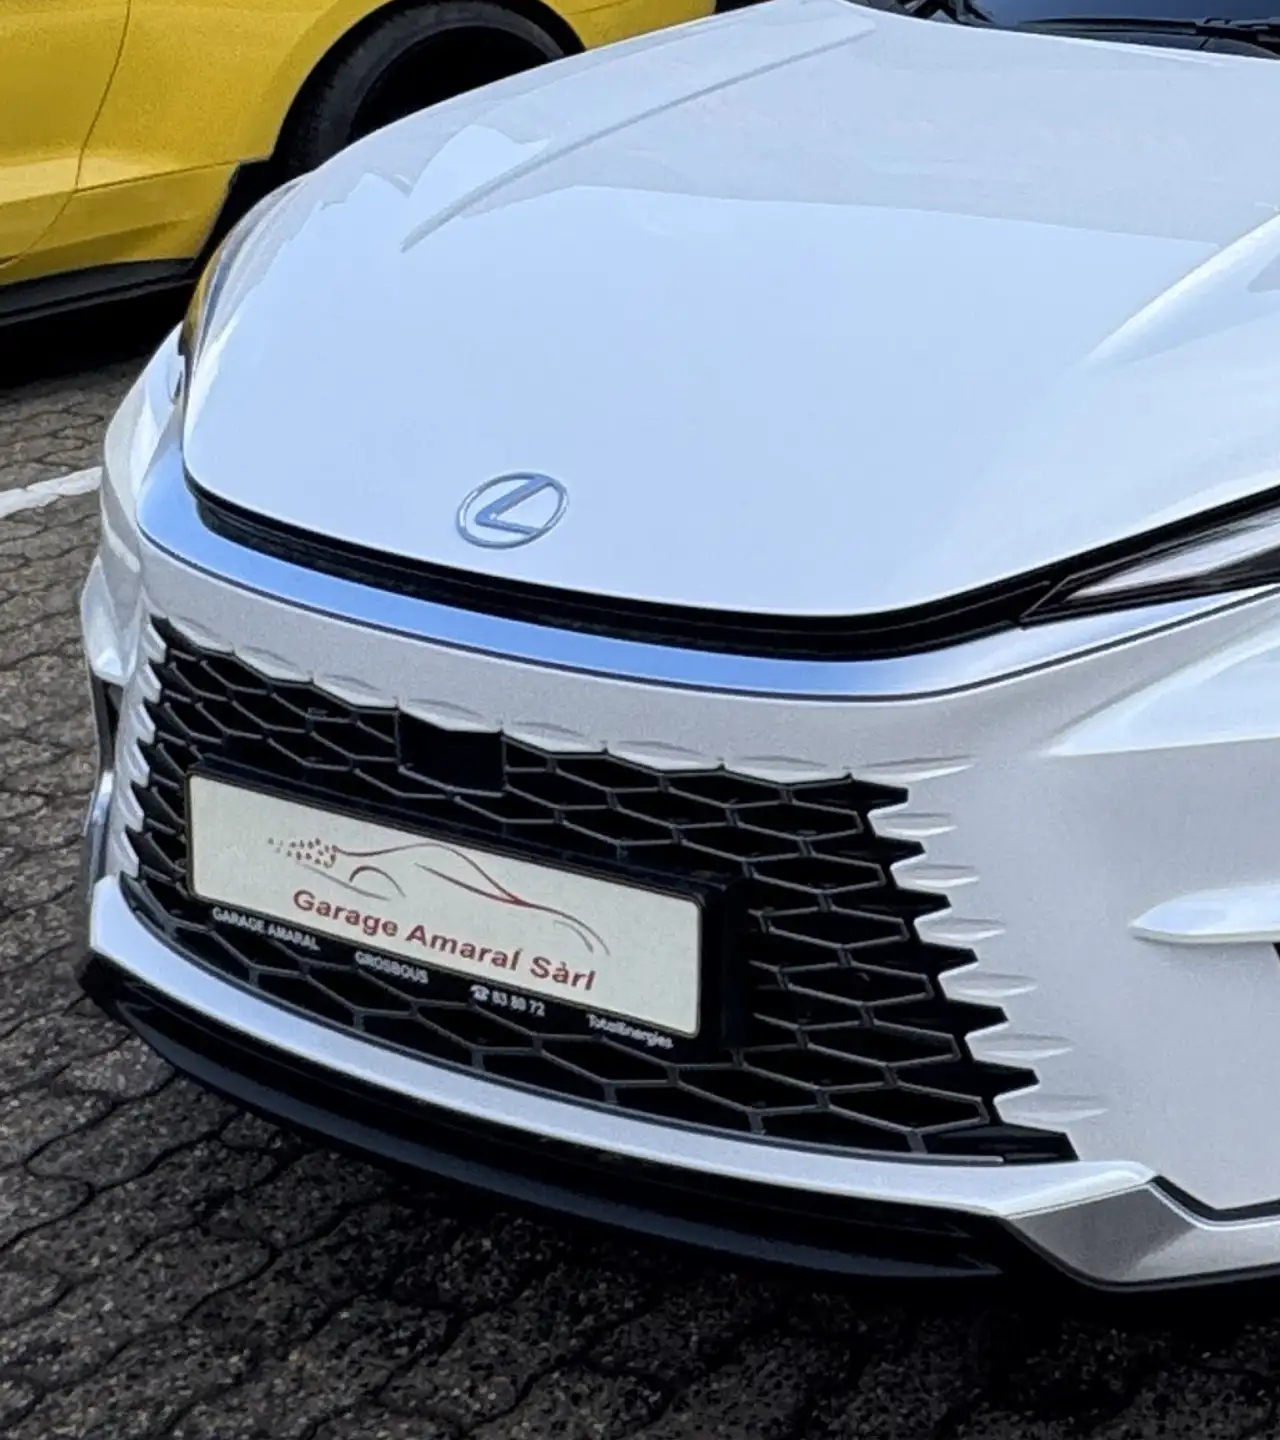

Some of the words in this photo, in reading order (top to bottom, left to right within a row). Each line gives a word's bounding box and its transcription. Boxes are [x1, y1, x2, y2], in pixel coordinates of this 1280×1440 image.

[211, 906, 266, 934] GARAGE
[266, 922, 321, 952] AMARAL
[293, 889, 399, 938] Garage
[404, 923, 524, 972] Amaral
